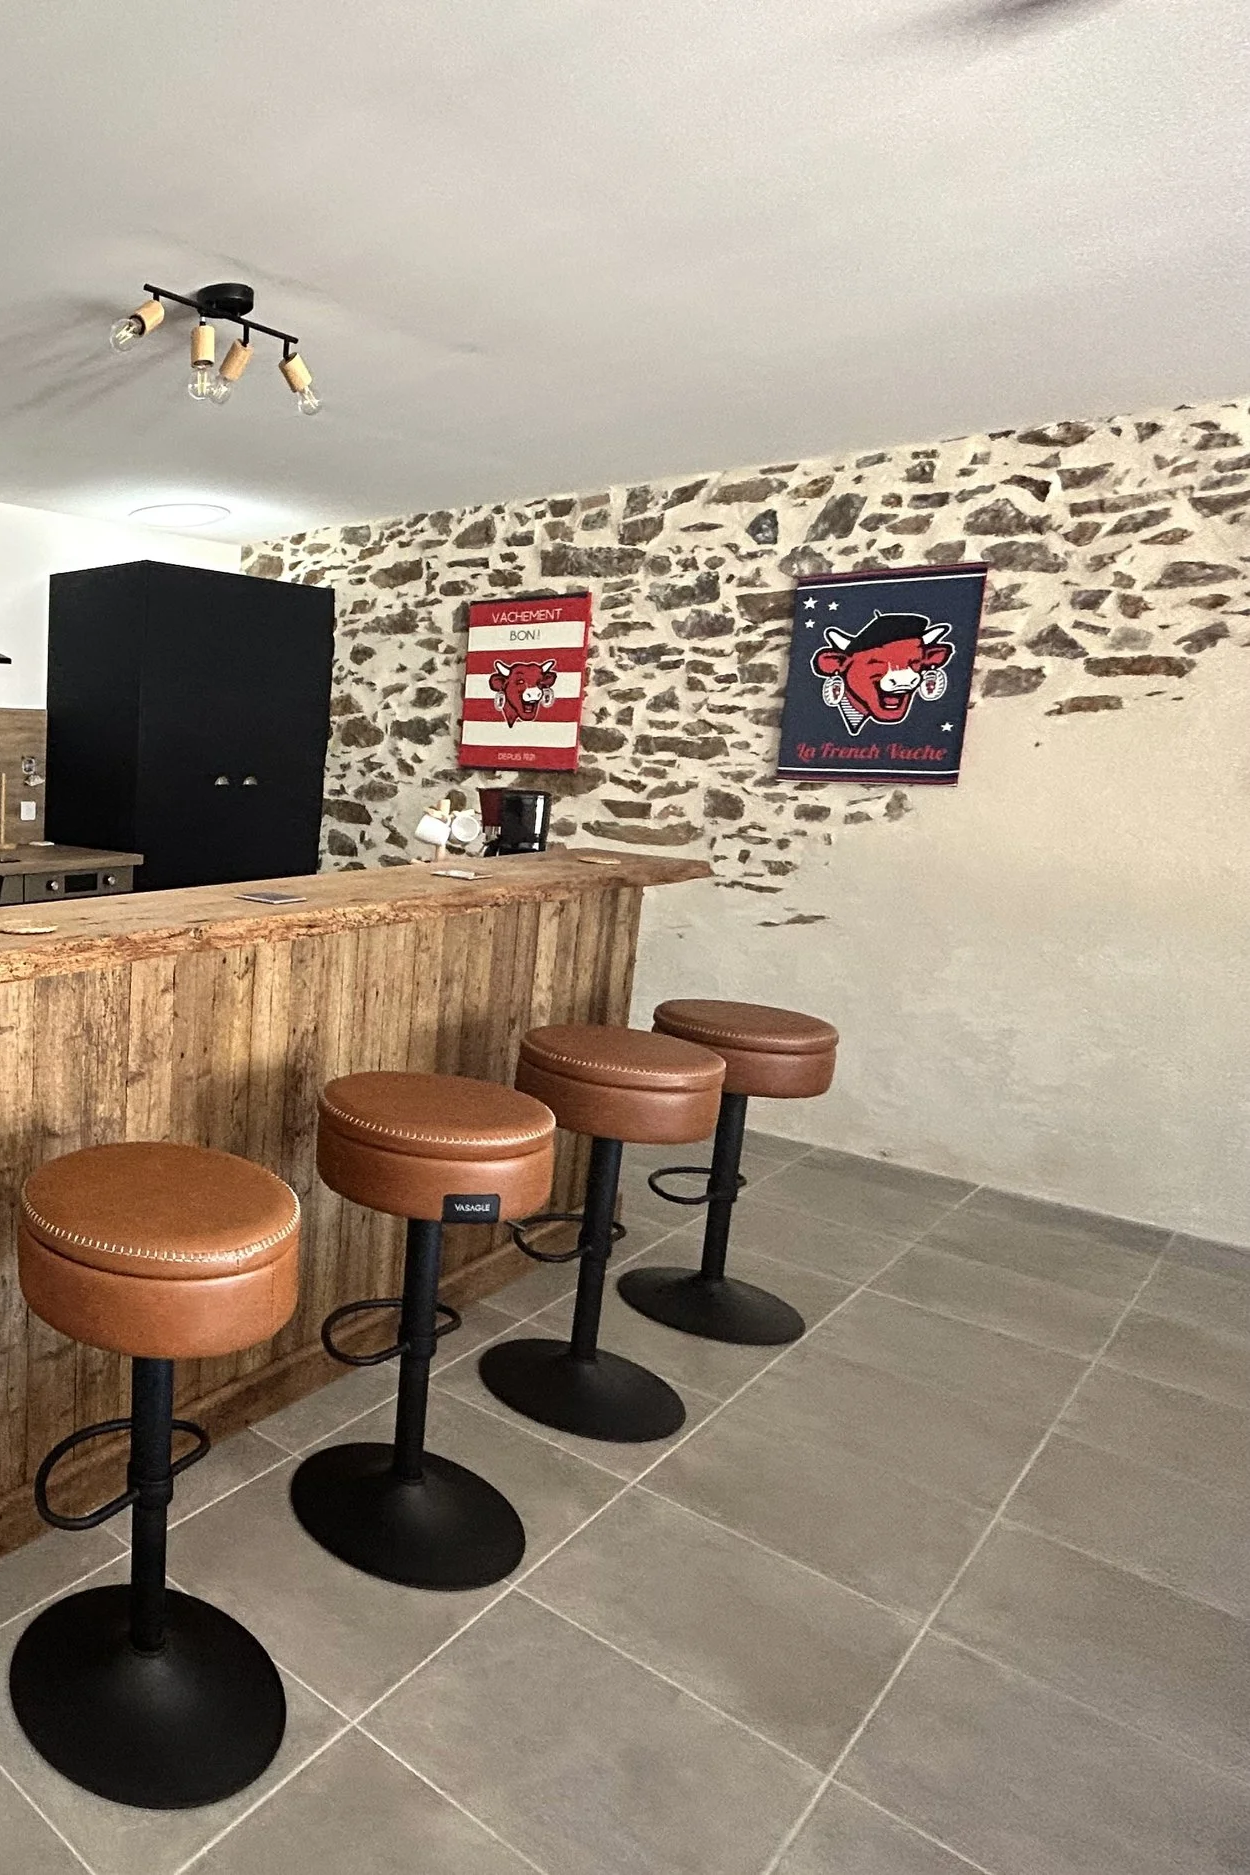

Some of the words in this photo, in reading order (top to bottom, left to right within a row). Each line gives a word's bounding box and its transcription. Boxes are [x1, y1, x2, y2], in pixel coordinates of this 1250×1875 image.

[491, 608, 563, 624] VACHEMENT
[497, 752, 522, 761] DEPUIS
[796, 743, 816, 762] La
[820, 741, 881, 760] French
[887, 742, 948, 762] Vache
[454, 1203, 491, 1212] VASAGLE
